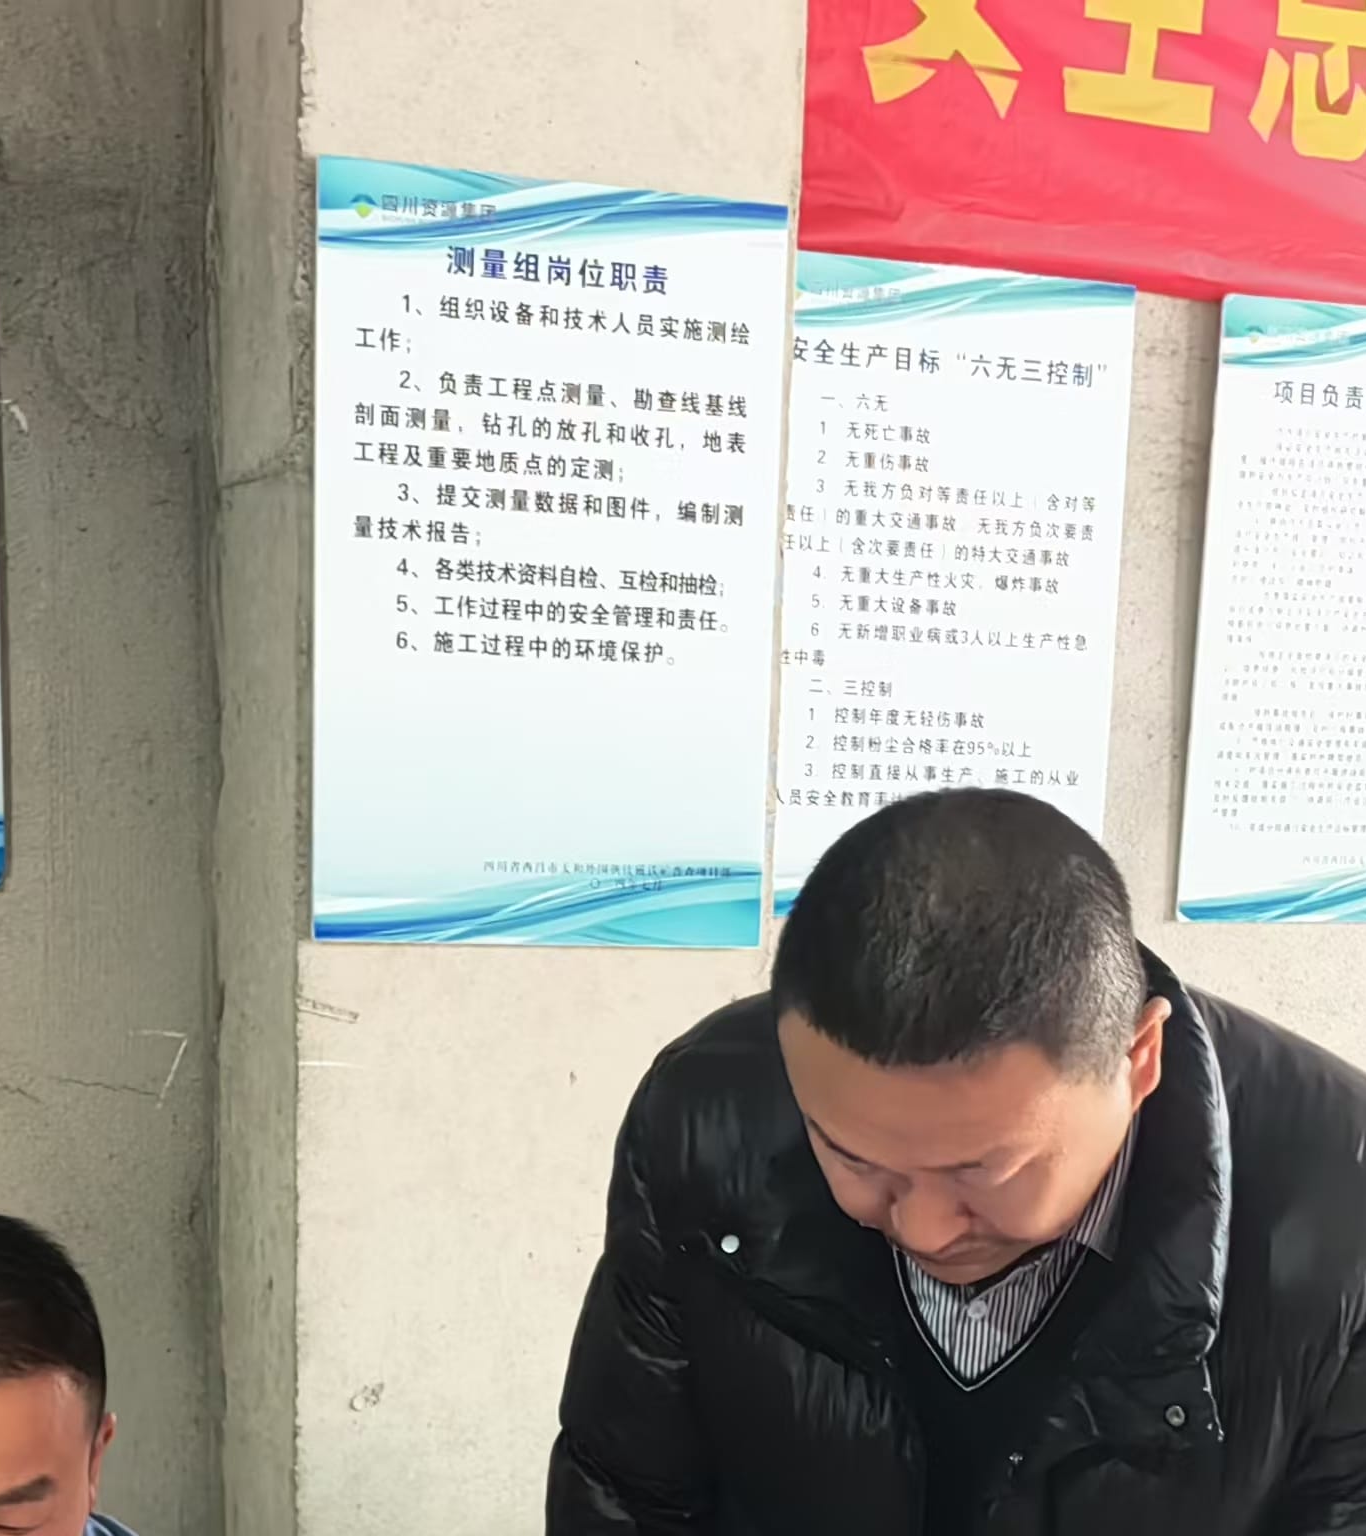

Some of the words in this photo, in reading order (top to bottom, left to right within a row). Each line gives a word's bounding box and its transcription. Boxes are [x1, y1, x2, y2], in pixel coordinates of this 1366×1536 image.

[446, 246, 667, 295] 测量组岗位职责
[403, 294, 749, 345] 1、组织设备和技术人员实施测绘
[355, 328, 410, 353] 工作；
[399, 370, 747, 418] 2、负责工程点测量、勘查线基线
[354, 442, 623, 482] 工程及重要地质点的定测；
[398, 483, 743, 526] 3、提交测量数据和图件，编制测
[354, 515, 480, 546] 量技术报告；
[397, 557, 723, 596] 4、各类技术资料自检、互检和抽检；
[397, 594, 728, 632] 5、工作过程中的安全管理和责任。
[396, 631, 675, 666] 6、施工过程中的环境保护。
